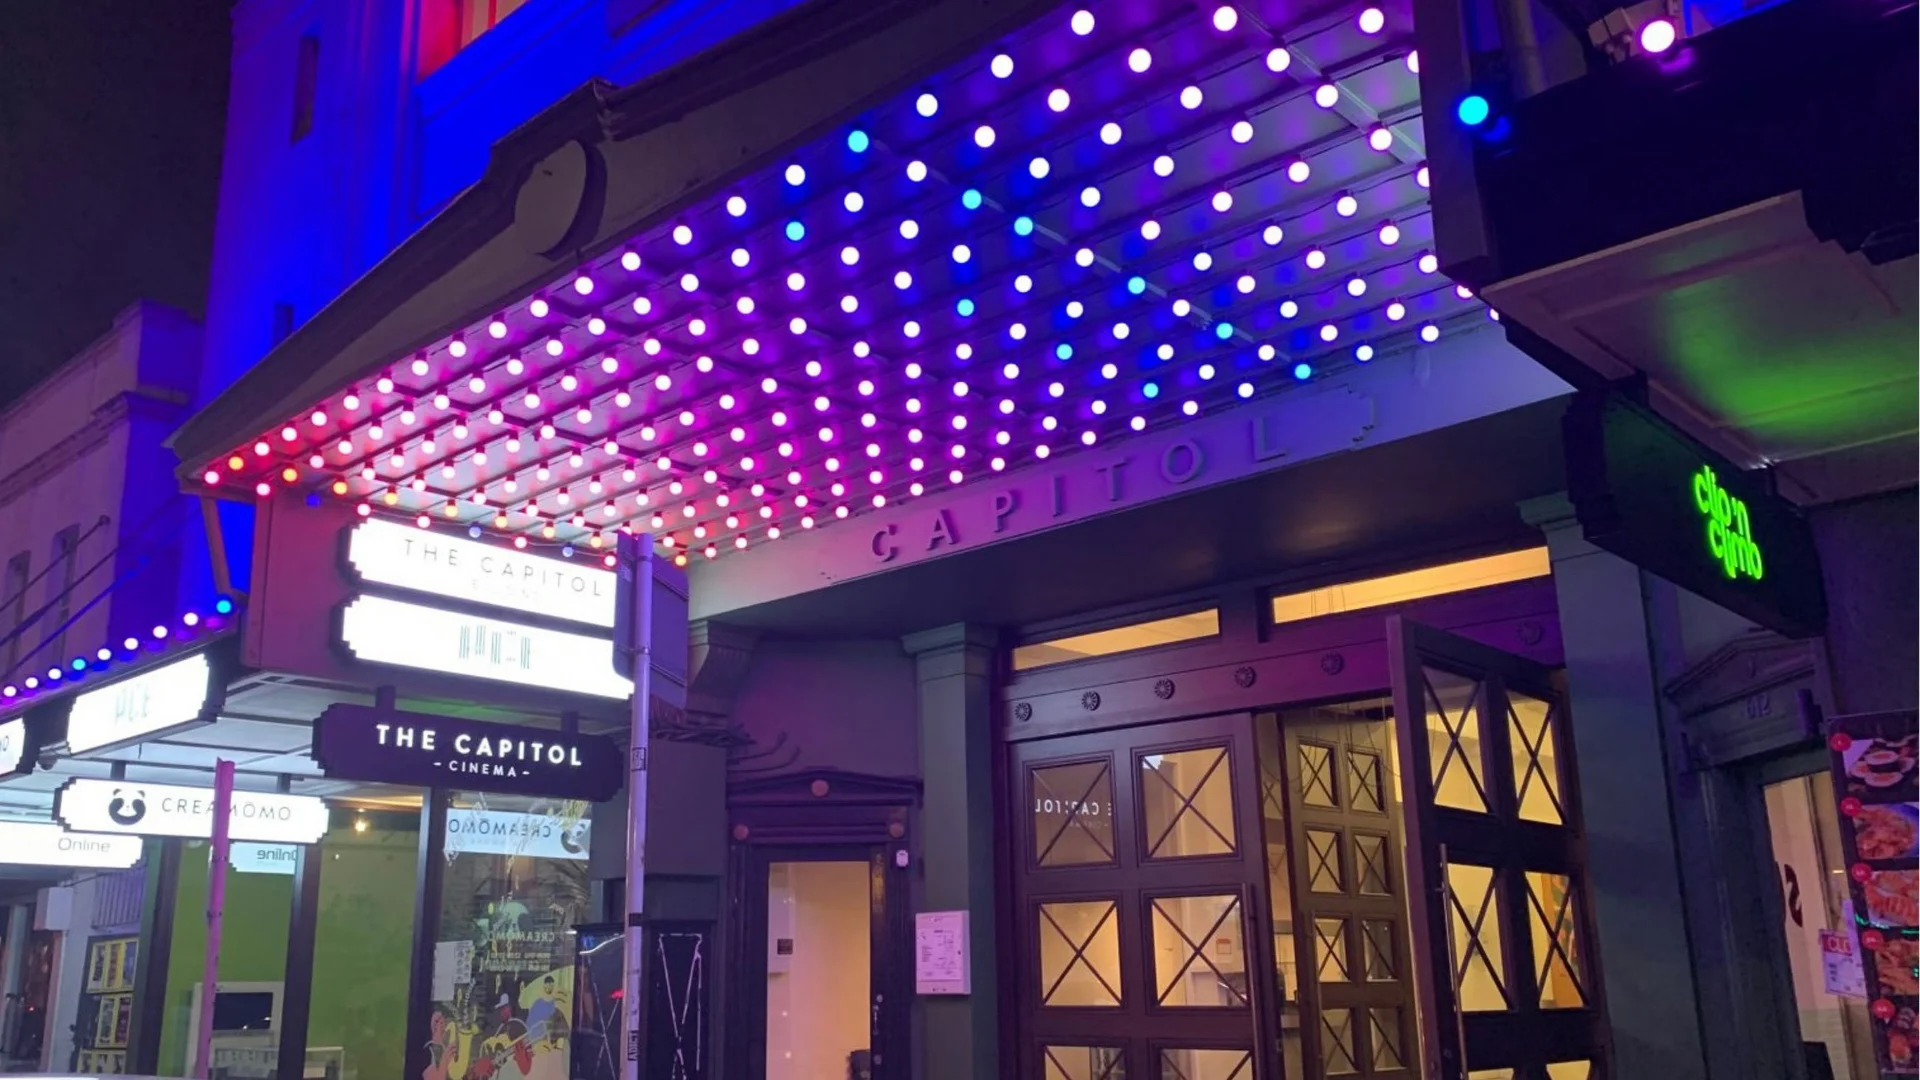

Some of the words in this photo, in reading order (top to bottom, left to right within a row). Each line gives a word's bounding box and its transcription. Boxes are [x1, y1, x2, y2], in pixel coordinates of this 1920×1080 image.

[870, 415, 1287, 563] CAPITOL
[404, 538, 458, 566] THE
[480, 556, 601, 597] CAPITOL
[1709, 519, 1762, 579] climb
[376, 723, 436, 750] THE
[454, 733, 582, 766] CAPITOL
[448, 760, 516, 777] CINEMA
[58, 837, 111, 852] Online
